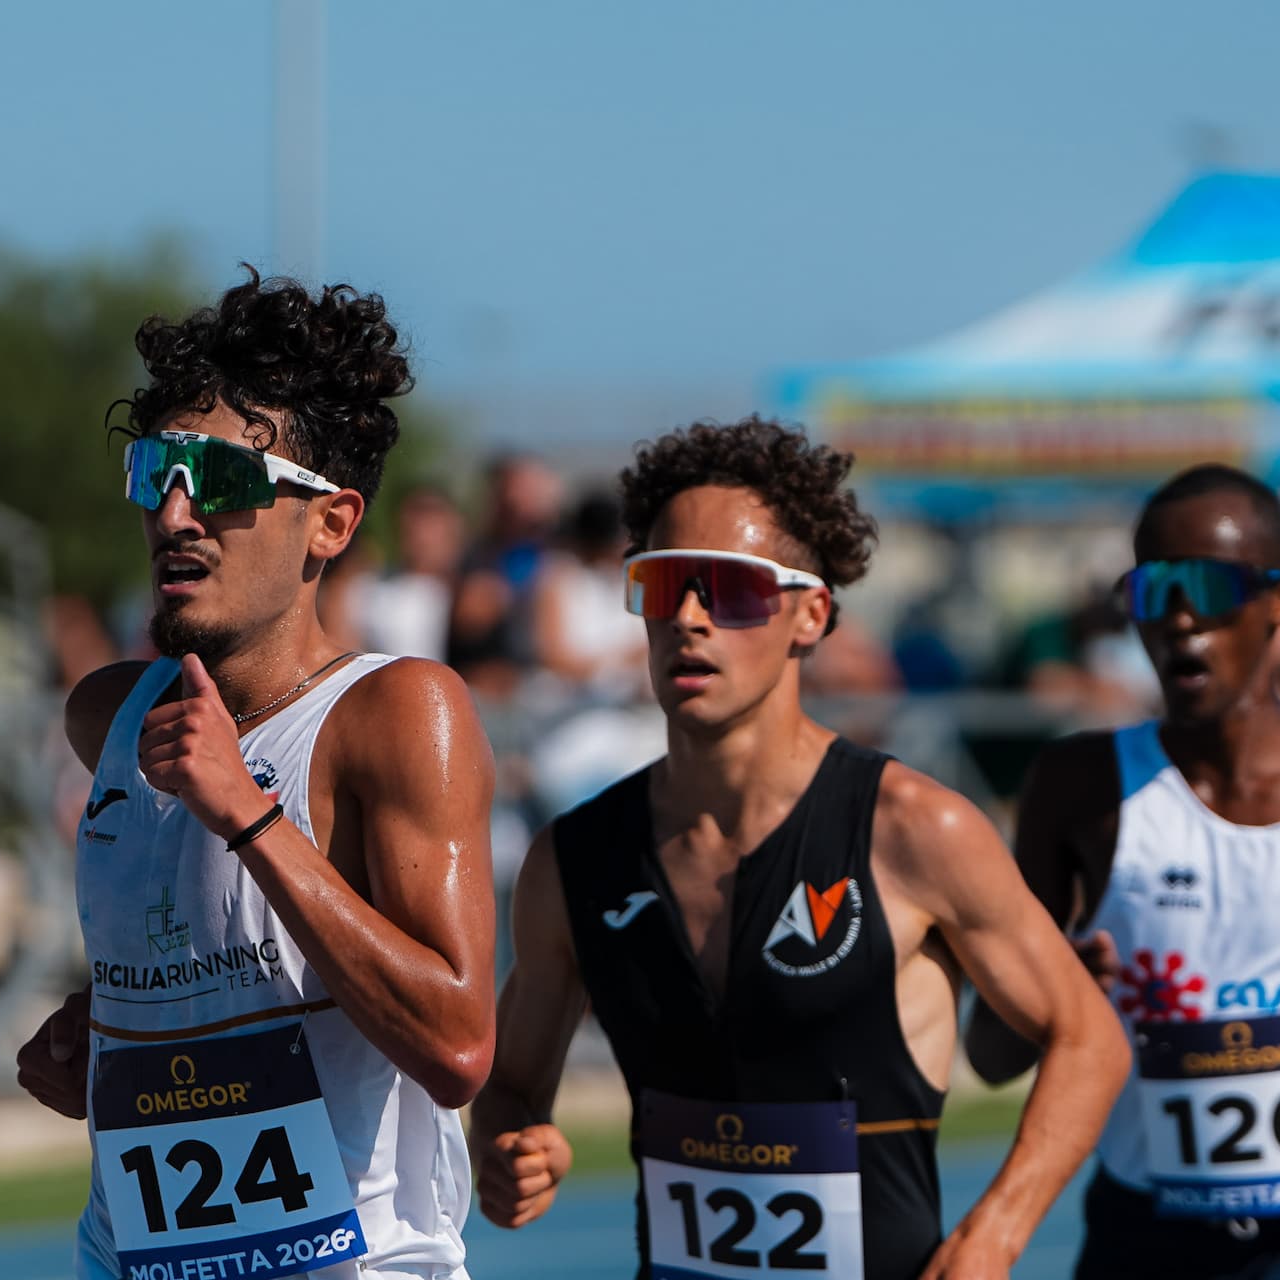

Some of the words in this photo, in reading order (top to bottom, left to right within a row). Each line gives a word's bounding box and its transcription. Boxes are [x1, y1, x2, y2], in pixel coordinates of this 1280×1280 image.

[226, 965, 284, 992] TEAM
[120, 1125, 315, 1233] 124
[277, 1228, 351, 1267] 2026
[667, 1181, 828, 1271] 122
